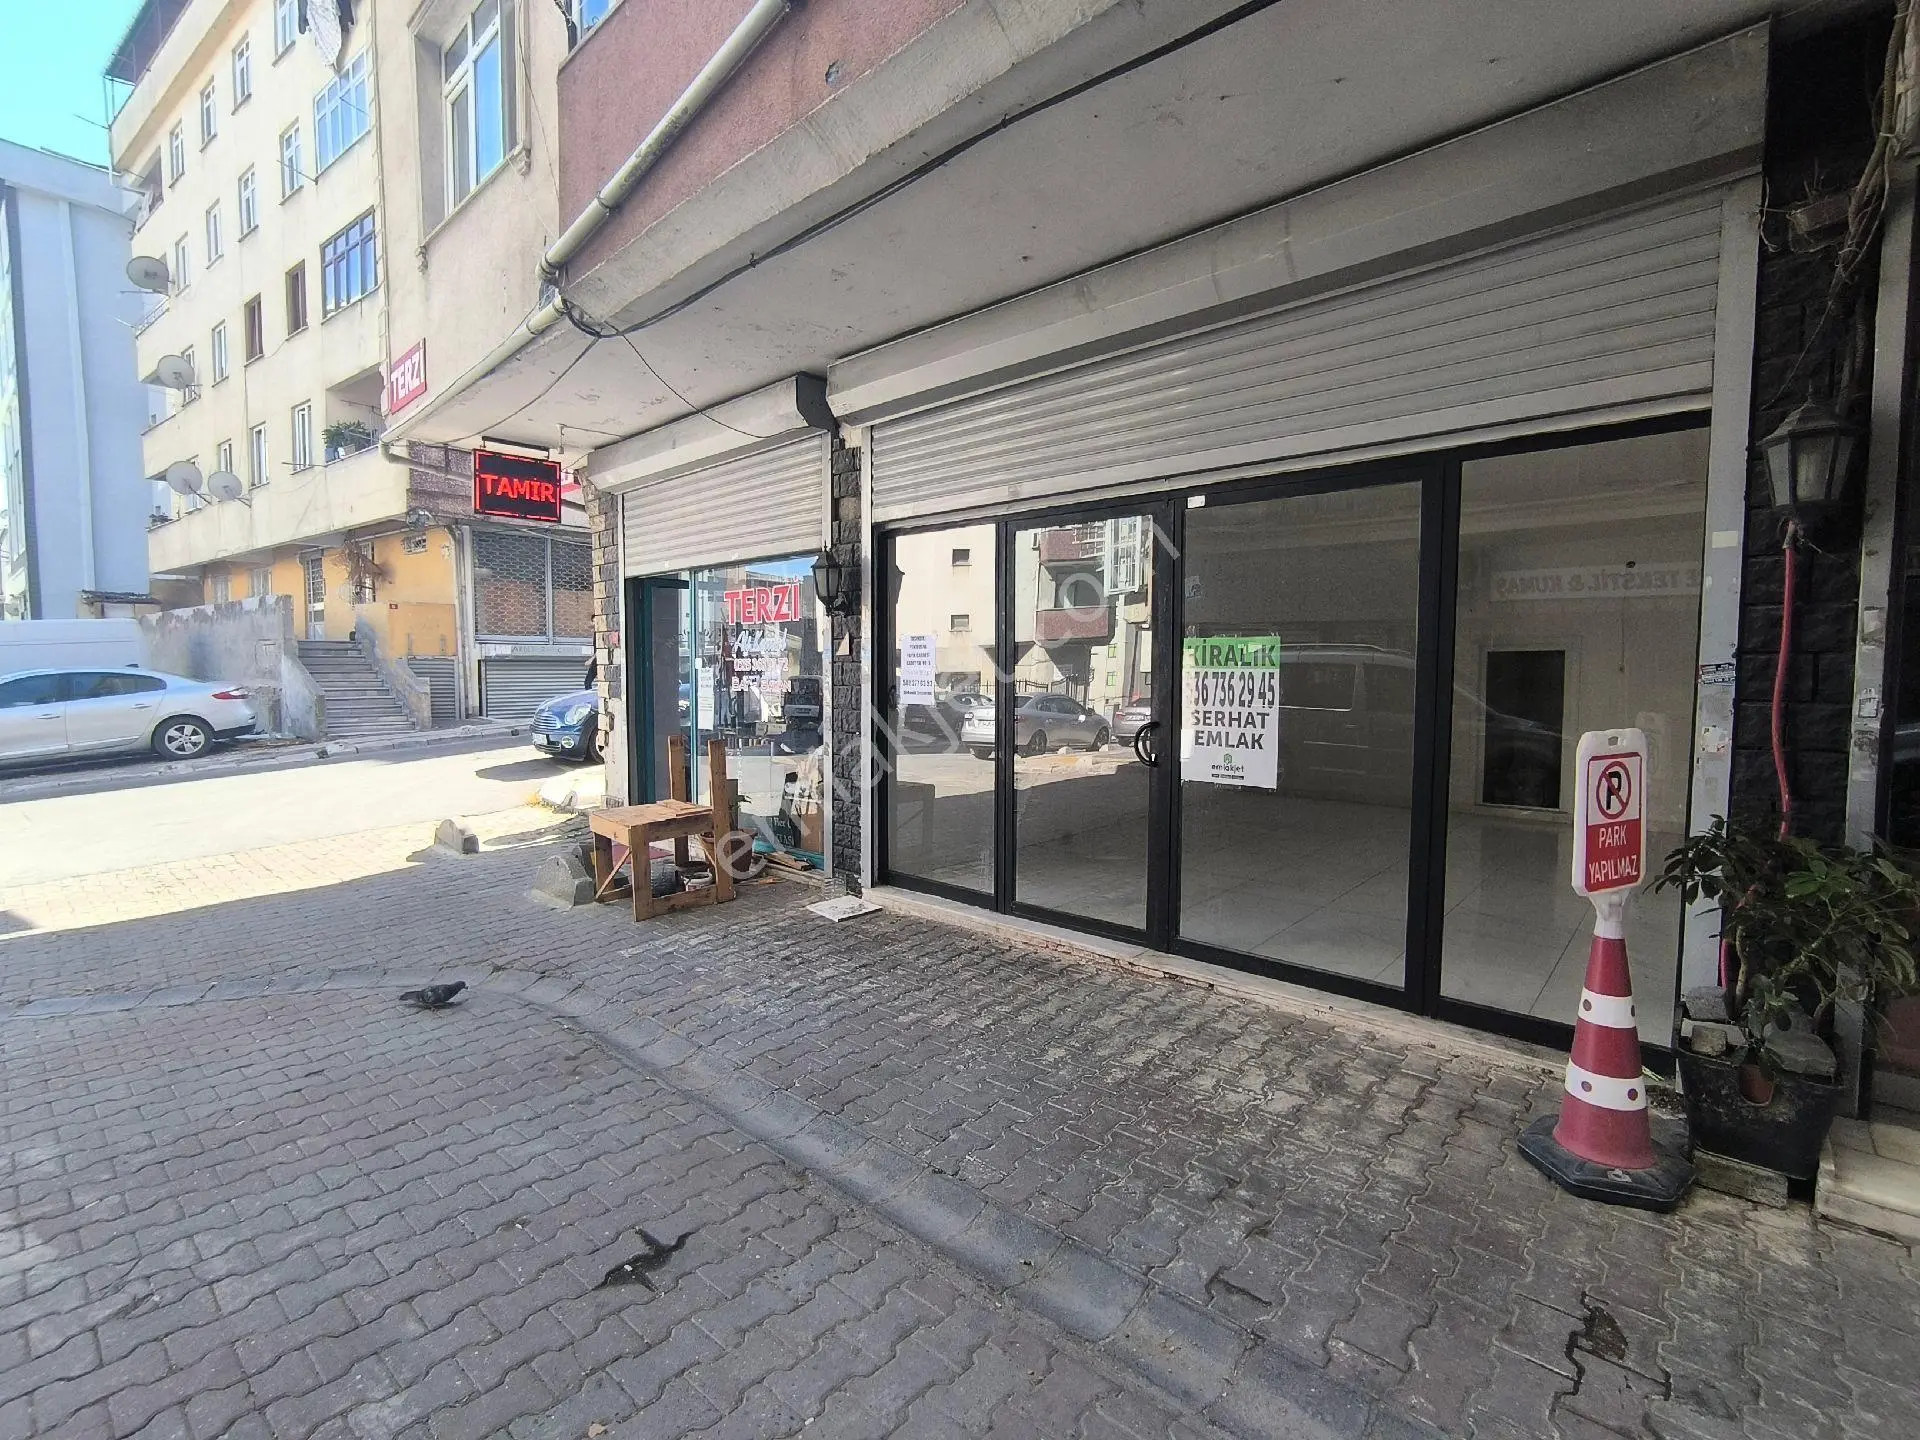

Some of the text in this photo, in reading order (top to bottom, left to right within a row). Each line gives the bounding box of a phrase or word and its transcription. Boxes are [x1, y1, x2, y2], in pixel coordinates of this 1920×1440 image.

[480, 473, 556, 503] TAMİR
[724, 577, 801, 625] TERZİ
[1211, 671, 1235, 707] 736
[1238, 671, 1255, 708] 29
[1258, 671, 1276, 709] 45
[1192, 709, 1270, 729] SERHAT
[1194, 730, 1264, 749] EMLAK
[1598, 824, 1627, 849] PARK
[1588, 855, 1638, 884] YAPILMAZ
